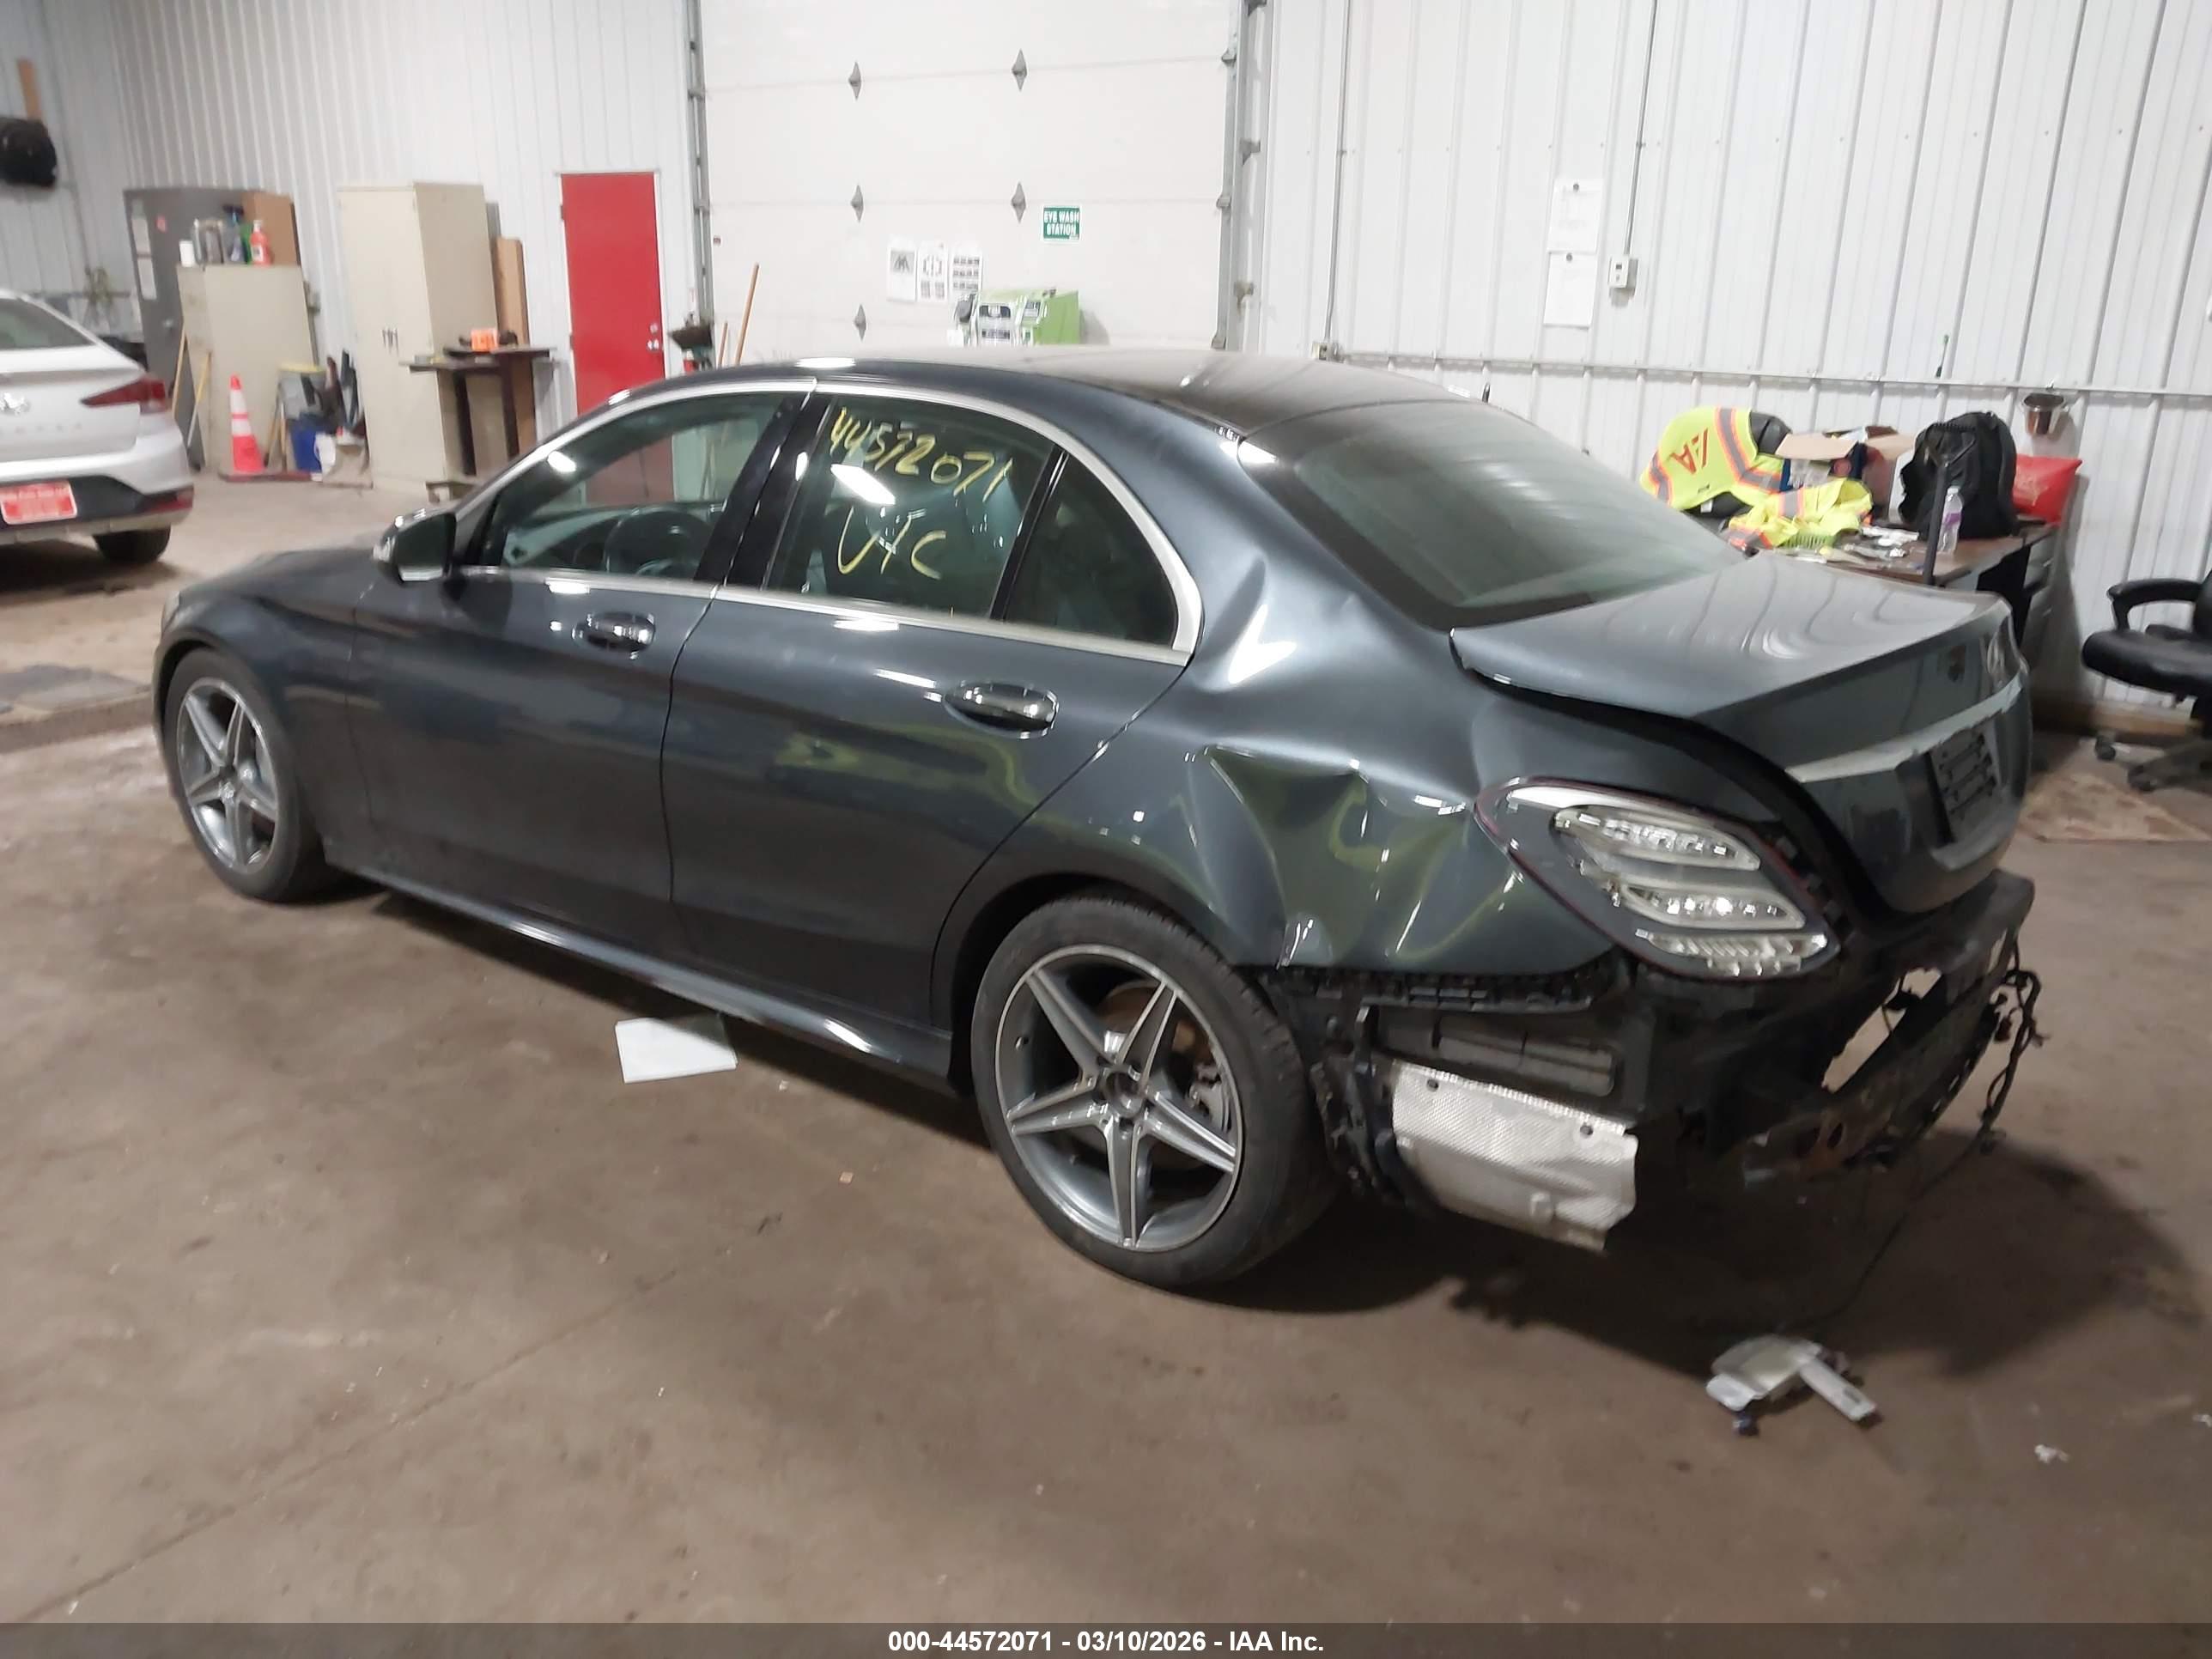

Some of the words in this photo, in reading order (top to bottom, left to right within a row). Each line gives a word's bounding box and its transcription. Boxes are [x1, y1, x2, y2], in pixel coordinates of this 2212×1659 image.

[1044, 210, 1057, 223] EYE
[1059, 210, 1079, 223] WASH
[1047, 223, 1077, 235] STATION
